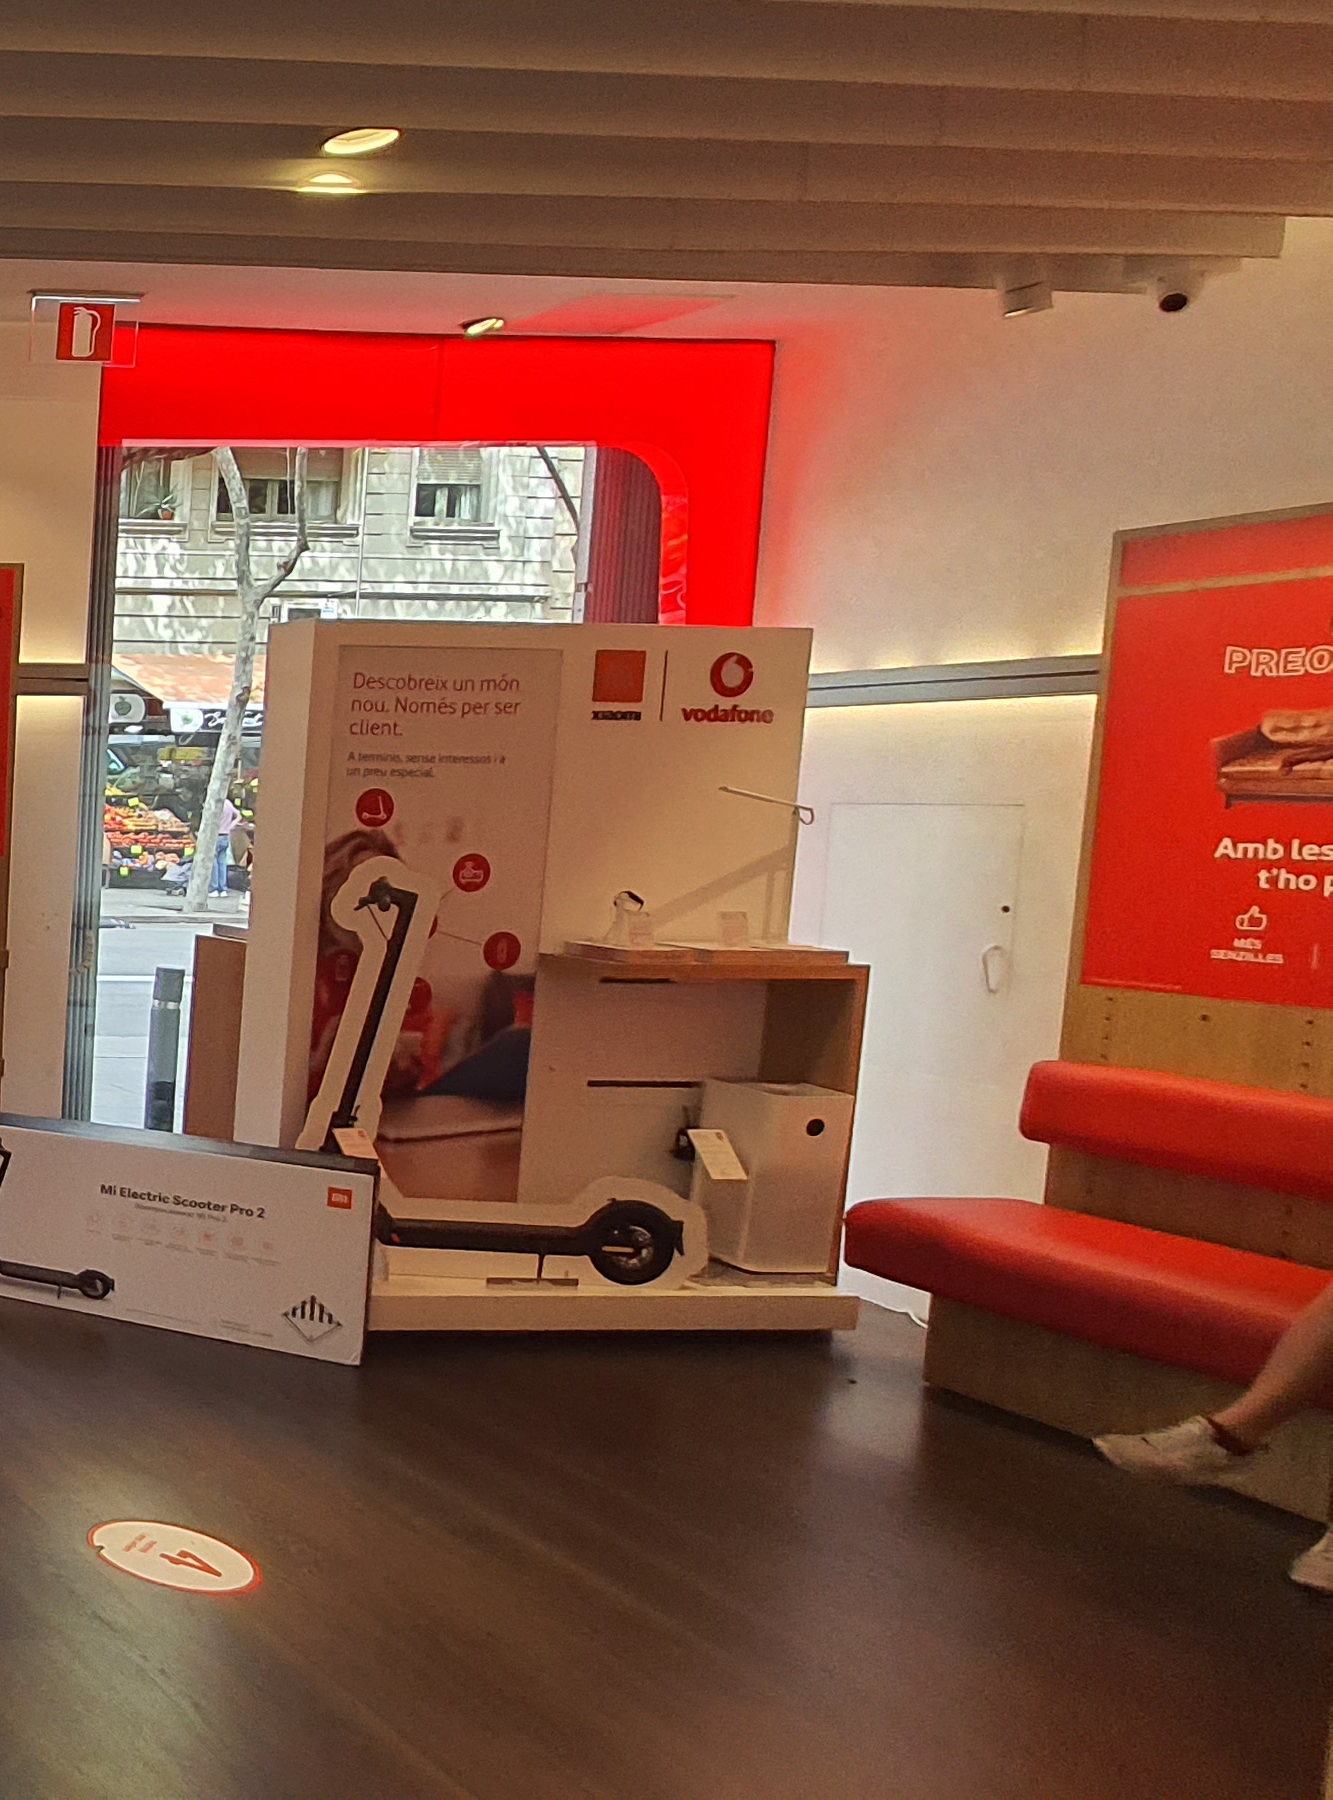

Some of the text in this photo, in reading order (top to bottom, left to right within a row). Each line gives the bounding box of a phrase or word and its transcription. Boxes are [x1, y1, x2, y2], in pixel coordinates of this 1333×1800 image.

[353, 672, 520, 692] Descobreix un món
[351, 696, 522, 718] nou. Només per ser
[681, 704, 775, 724] vodafone
[349, 719, 403, 737] client.
[347, 752, 356, 761] A
[405, 754, 436, 764] sense
[346, 768, 361, 777] un
[363, 768, 388, 779] preu
[1214, 837, 1333, 861] Amb les
[1257, 867, 1318, 890] t'ho
[100, 1184, 266, 1219] Mi Electric Scooter Pro 2
